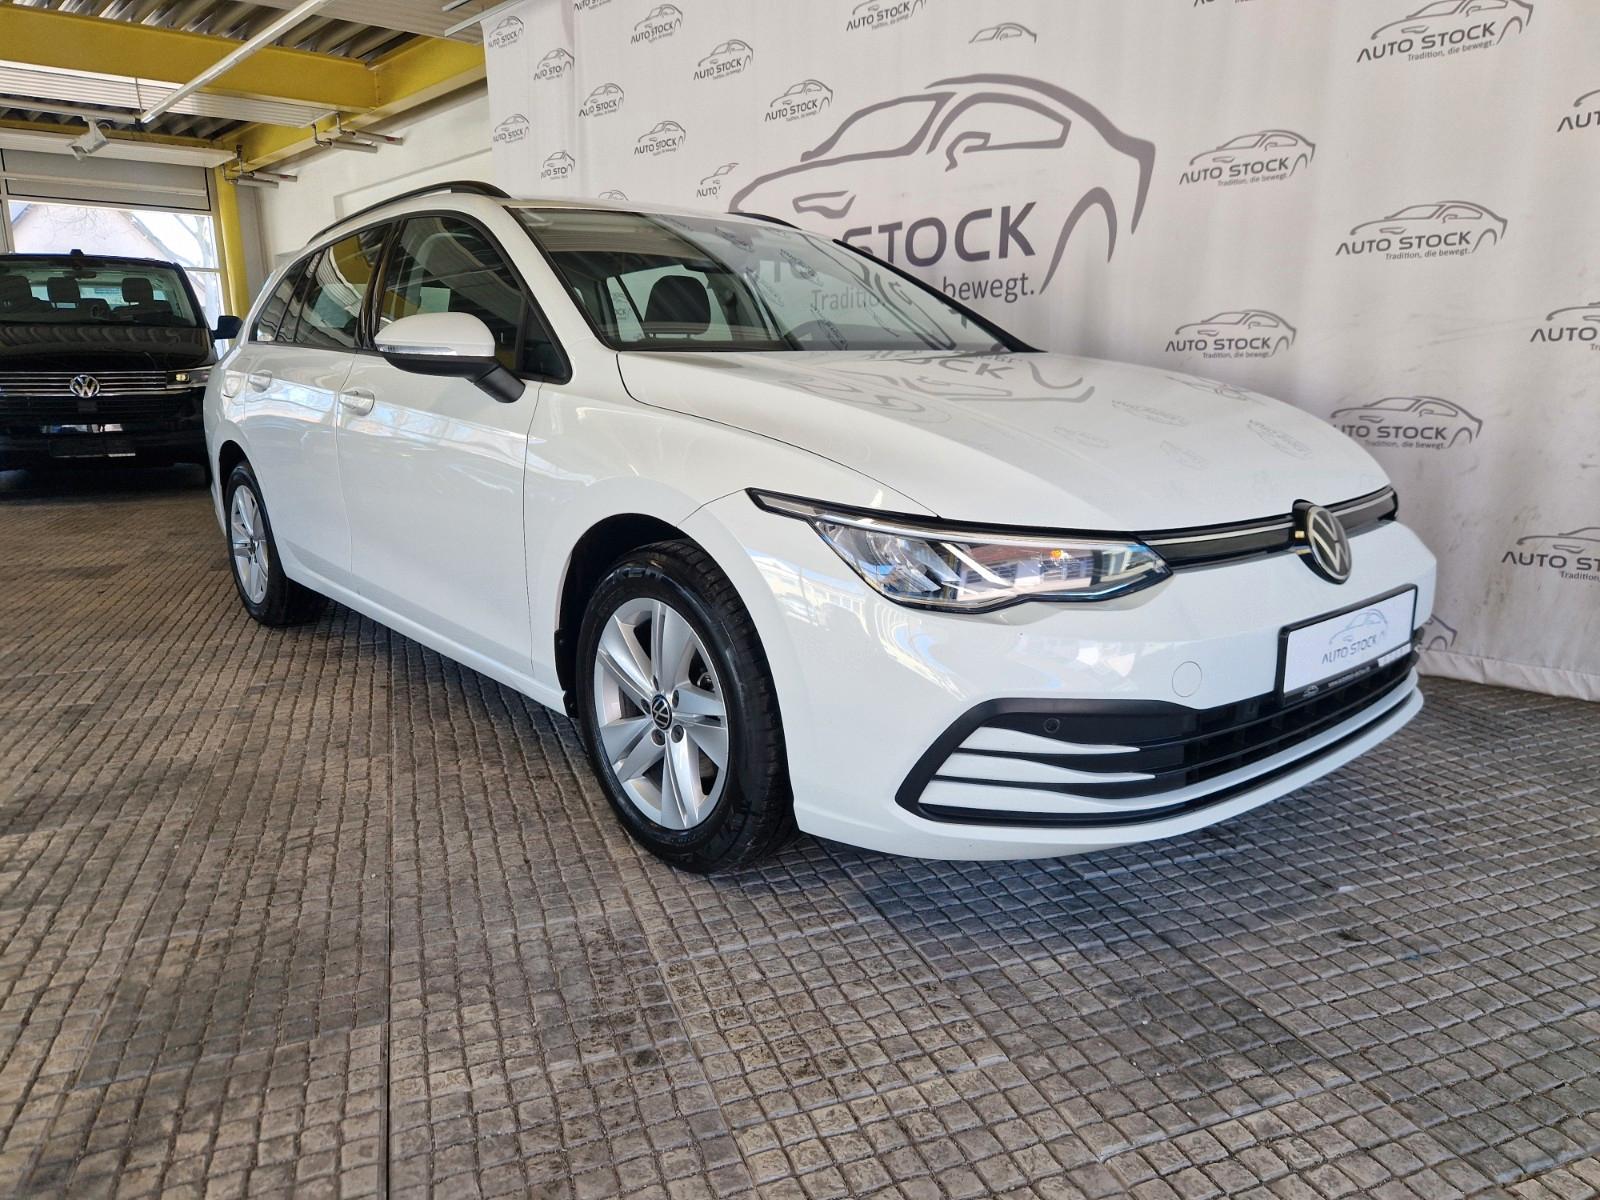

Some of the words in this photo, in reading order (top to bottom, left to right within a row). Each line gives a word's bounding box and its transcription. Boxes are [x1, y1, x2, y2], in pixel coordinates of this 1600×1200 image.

[846, 14, 874, 31] AUTO
[876, 2, 910, 21] STOCK
[631, 30, 651, 44] AUTO
[651, 21, 674, 37] STOCK
[1356, 38, 1414, 63] AUTO
[1421, 21, 1497, 50] STOCK
[1408, 49, 1445, 62] Tradition,
[1447, 45, 1461, 55] die
[693, 67, 714, 80] AUTO
[716, 58, 742, 73] STOCK
[595, 99, 617, 111] STOCK
[764, 108, 788, 122] AUTO
[789, 98, 818, 115] STOCK
[634, 144, 655, 155] AUTO
[656, 137, 677, 151] STOCK
[1179, 166, 1223, 185] AUTO
[1228, 157, 1289, 178] STOCK
[696, 186, 718, 198] AUTO
[1335, 238, 1392, 256] AUTO
[1398, 230, 1471, 250] STOCK
[1385, 251, 1422, 261] Tradition,
[1424, 249, 1437, 258] die
[943, 272, 1034, 303] bewegt.
[1165, 339, 1208, 353] AUTO
[1213, 337, 1271, 351] STOCK
[1530, 327, 1598, 343] AUTO
[1376, 425, 1447, 440] STOCK
[1501, 551, 1567, 569] AUTO
[1321, 646, 1349, 665] AUTO
[1350, 634, 1377, 656] STOCK
